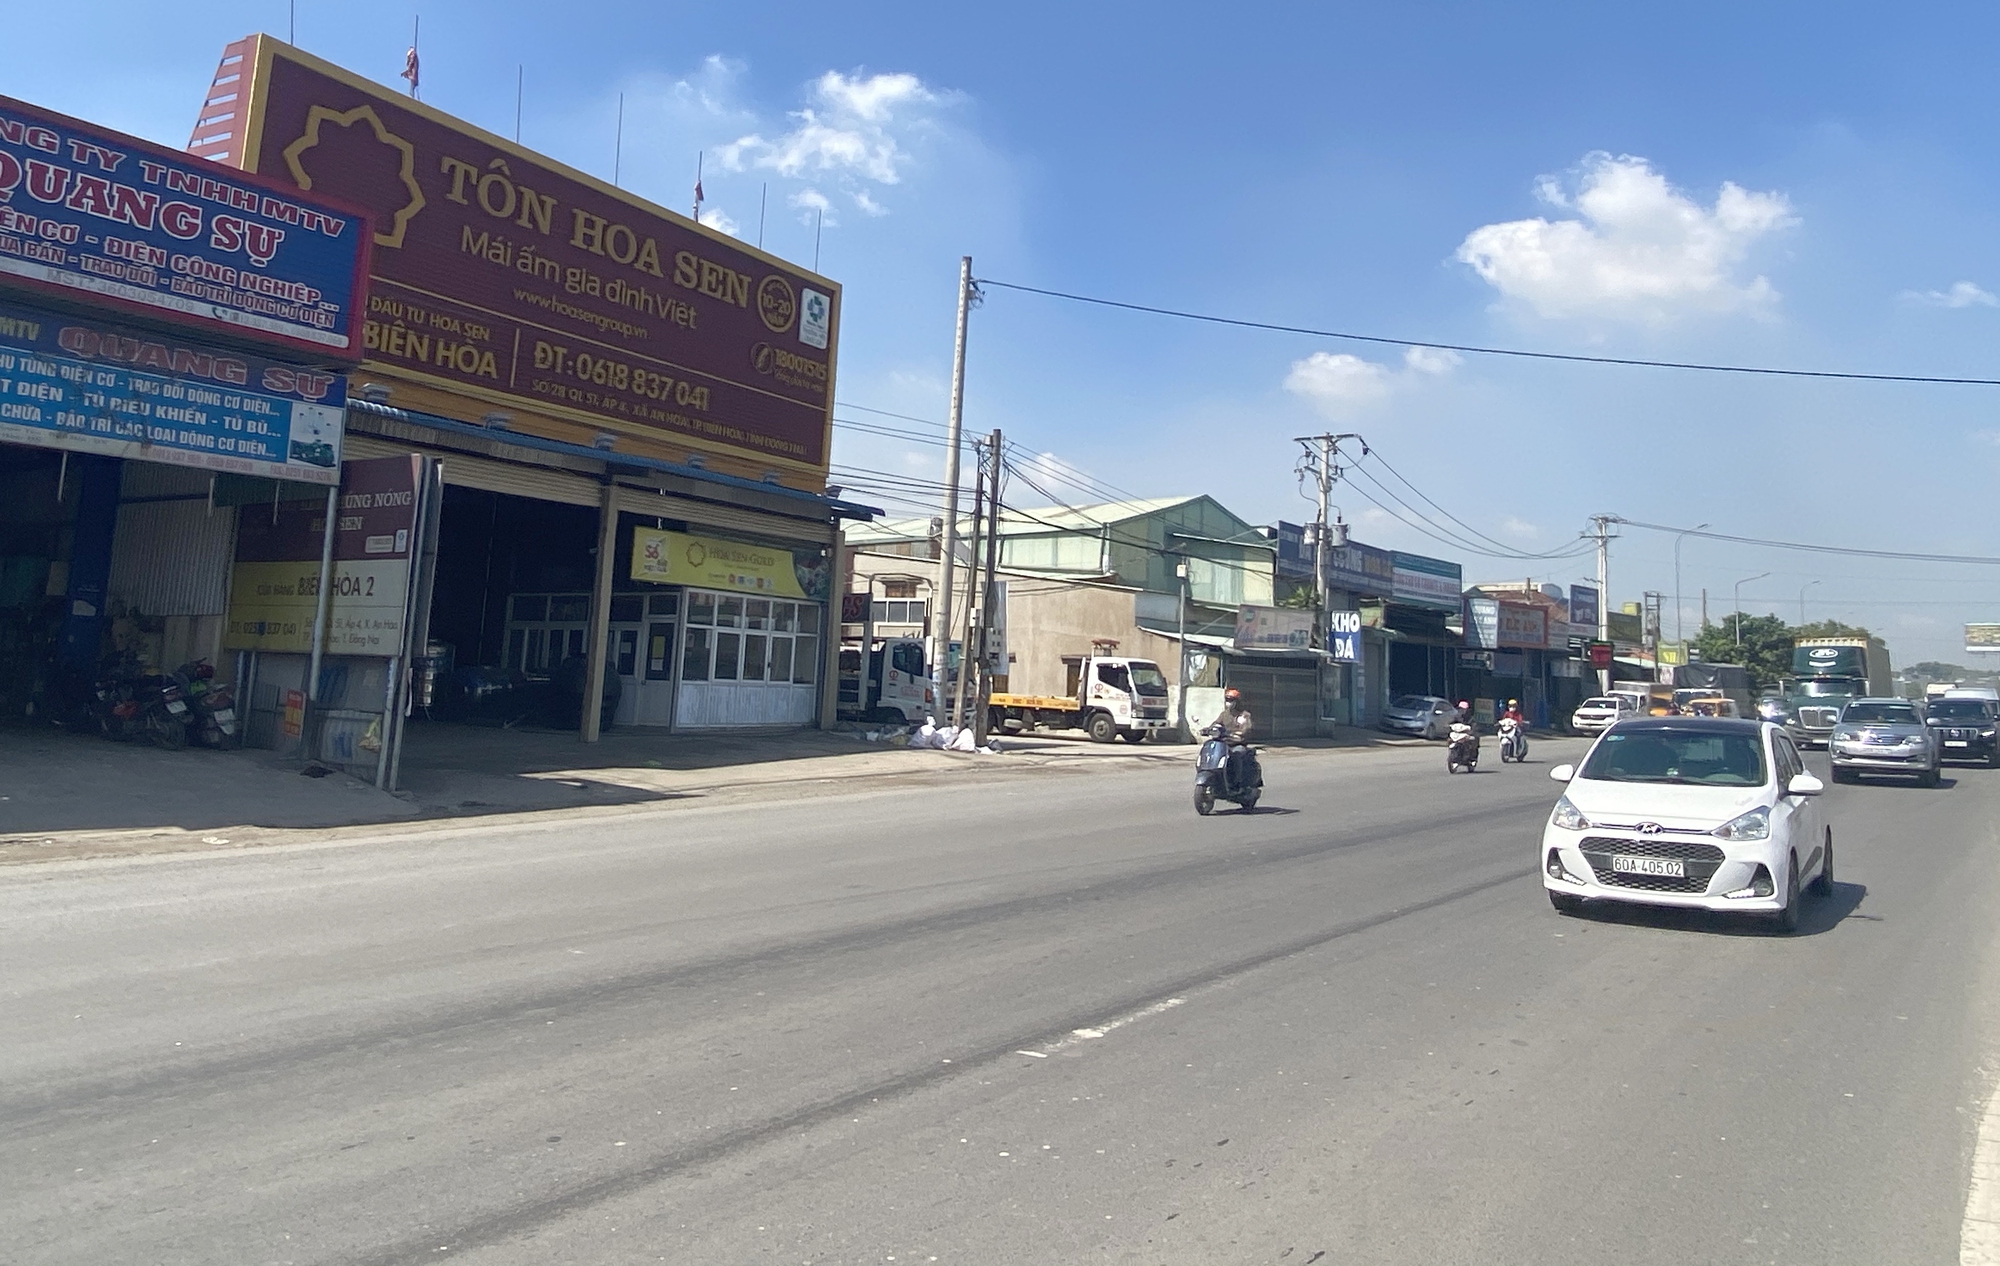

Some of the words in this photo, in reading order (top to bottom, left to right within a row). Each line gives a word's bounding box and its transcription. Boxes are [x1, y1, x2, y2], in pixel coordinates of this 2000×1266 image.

[67, 138, 127, 173] TY
[139, 159, 258, 213] TNHH
[261, 197, 346, 237] MTV
[39, 219, 80, 245] CƠ
[104, 236, 167, 268] ĐIỆN
[171, 254, 237, 286] CÔNG
[211, 214, 285, 267] SỰ
[441, 156, 558, 236] TÔN
[570, 208, 664, 278] HOA
[674, 251, 752, 309] SEN
[80, 254, 126, 279] TRAO
[461, 225, 512, 268] Mái
[516, 245, 560, 283] ấm
[565, 267, 600, 298] gia
[605, 279, 653, 314] đình
[655, 294, 697, 329] Việt
[363, 318, 430, 363] BIÊN
[435, 338, 498, 380] HÒA
[429, 313, 461, 334] HOA
[464, 322, 490, 342] SEN
[58, 327, 247, 385] QUANG
[262, 367, 335, 403] SỰ
[632, 368, 675, 402] 837
[17, 381, 63, 403] ĐIỆN
[97, 372, 116, 387] CƠ
[224, 395, 241, 411] CƠ
[1, 402, 41, 422] CHỮA
[218, 437, 235, 451] CƠ
[365, 576, 376, 597] 2
[1332, 612, 1360, 633] KHO
